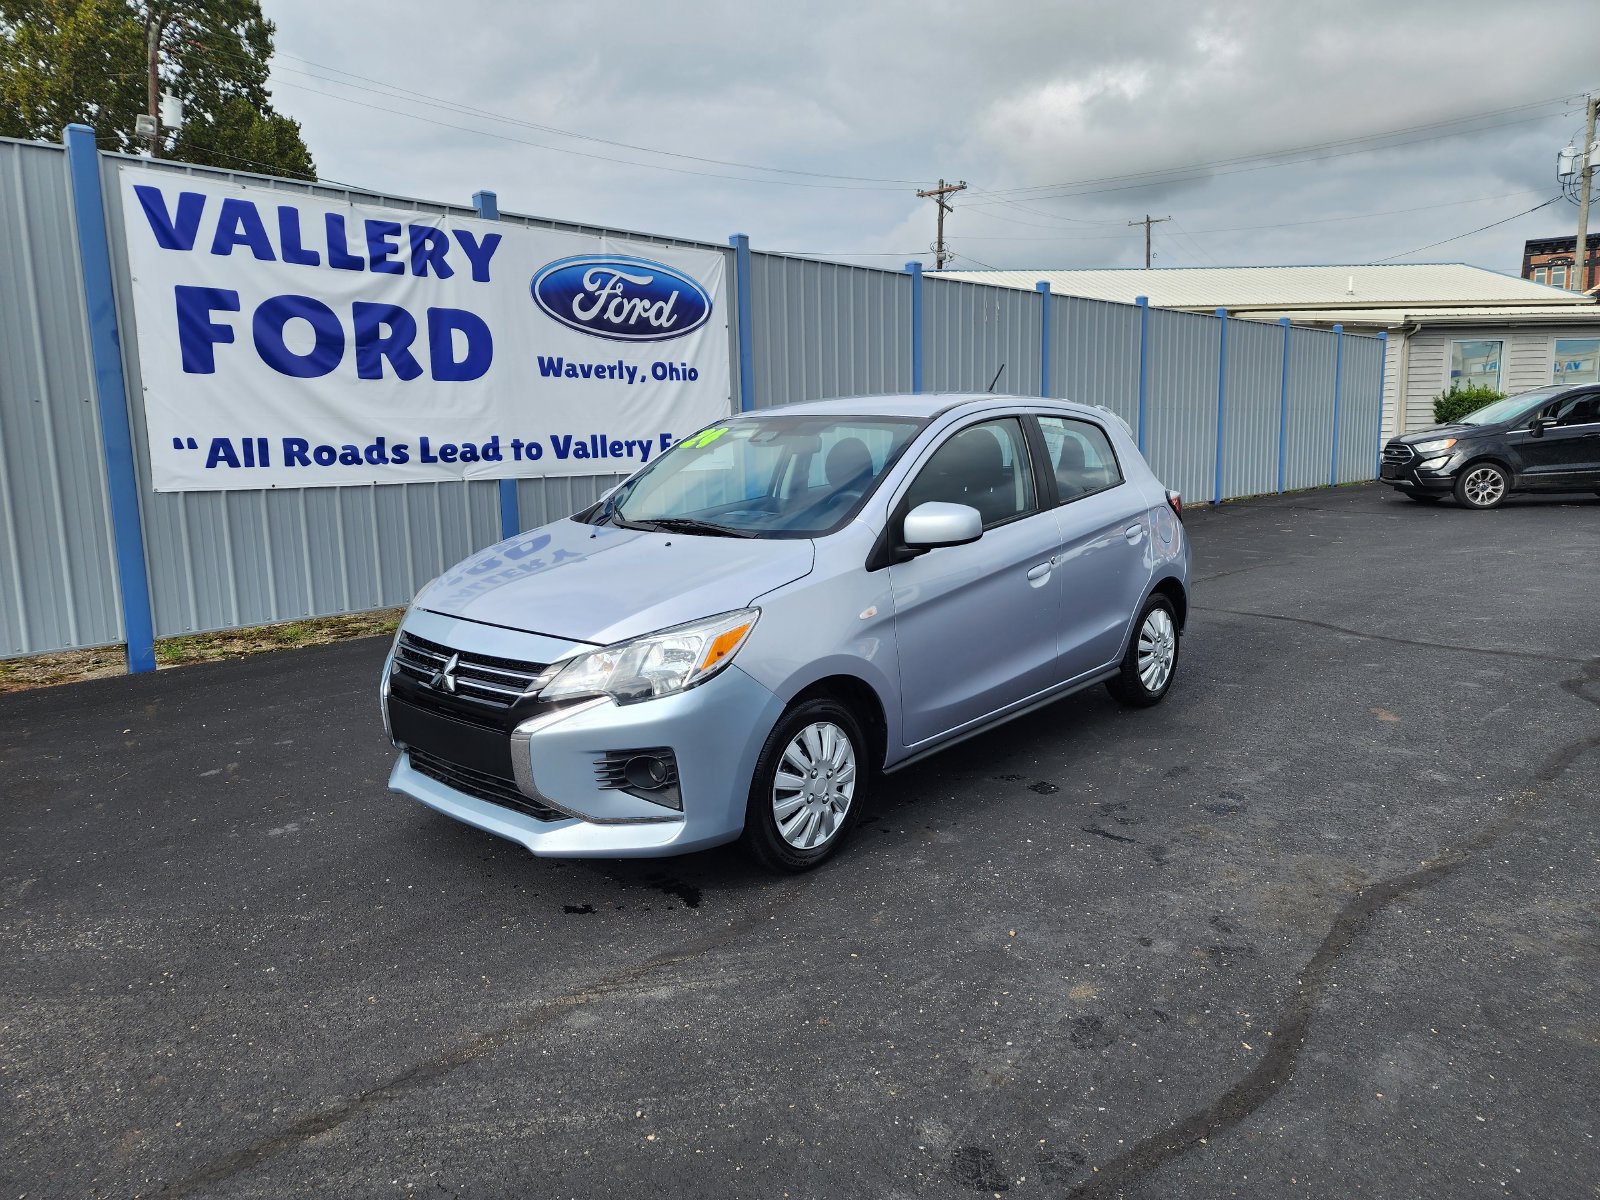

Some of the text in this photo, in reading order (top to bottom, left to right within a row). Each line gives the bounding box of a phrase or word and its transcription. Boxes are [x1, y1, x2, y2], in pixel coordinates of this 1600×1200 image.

[133, 184, 502, 283] VALLERY
[572, 267, 680, 328] Ford
[175, 284, 493, 382] FORD
[537, 355, 699, 384] Waverly, Ohio
[282, 436, 410, 467] Roads
[419, 435, 503, 464] Lead
[511, 438, 543, 461] to
[550, 434, 653, 463] Vallery
